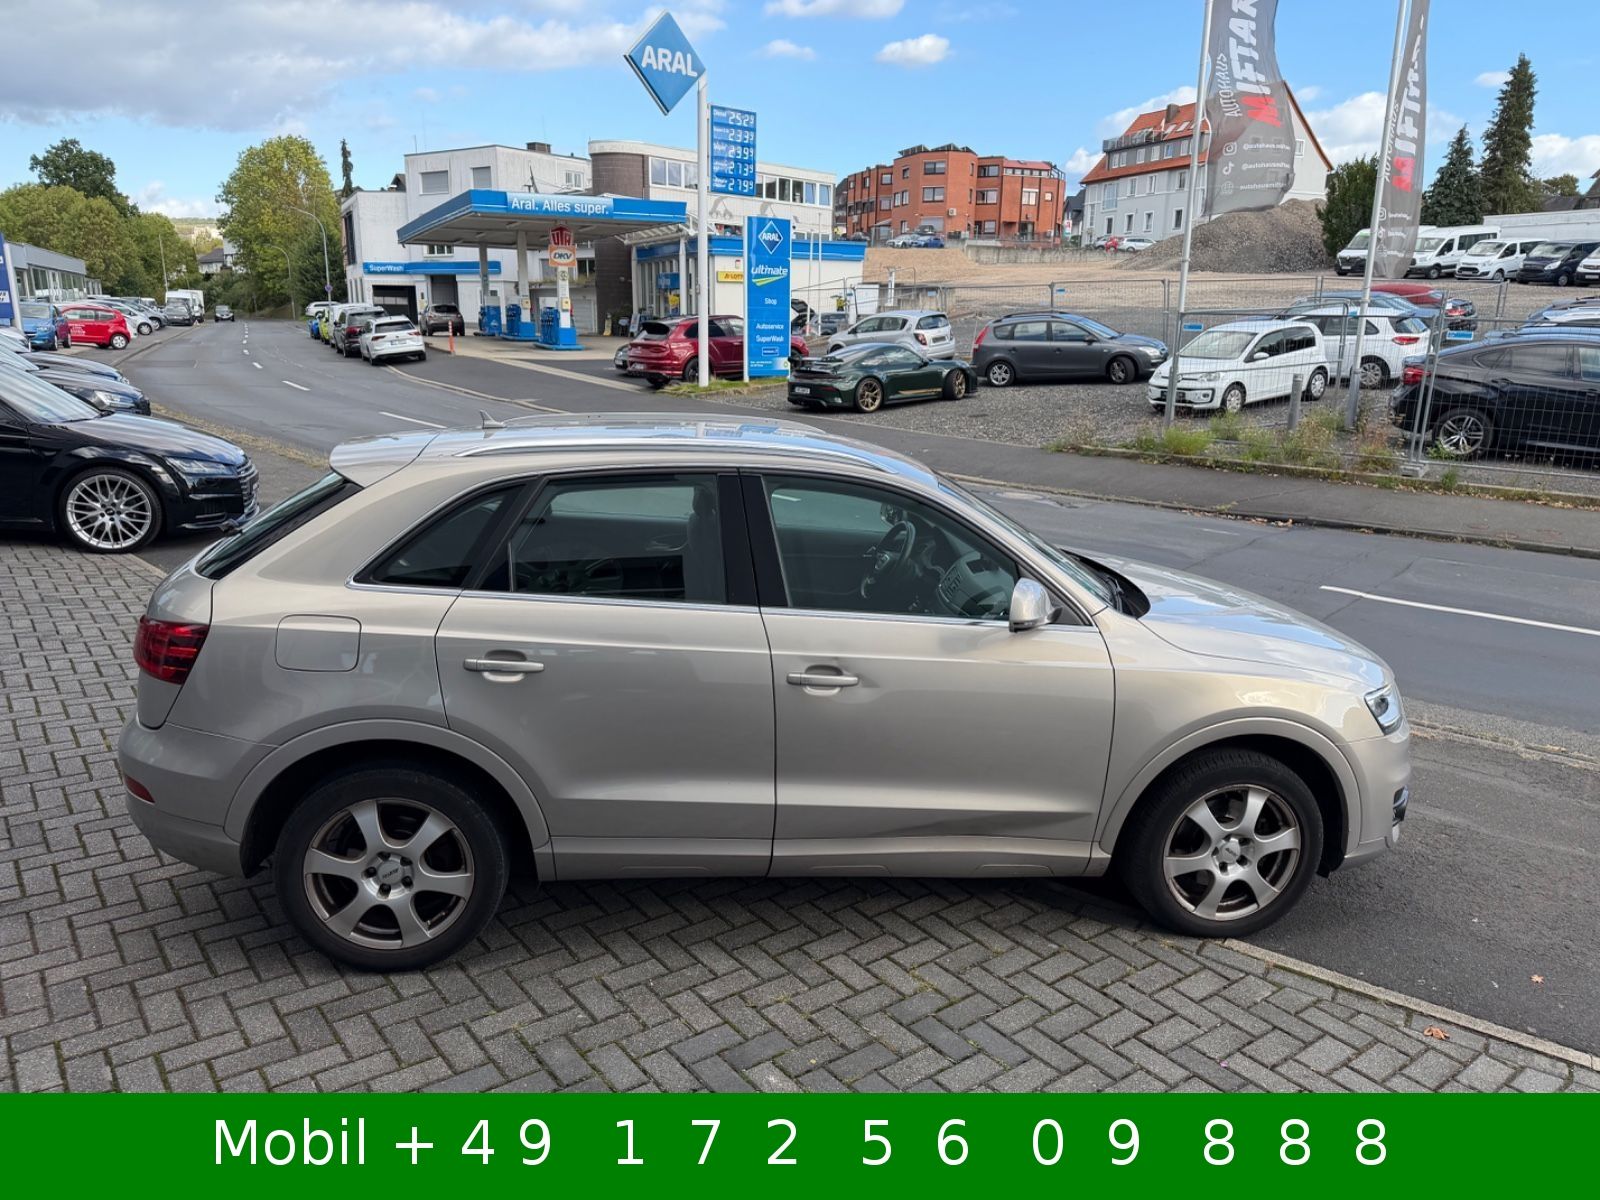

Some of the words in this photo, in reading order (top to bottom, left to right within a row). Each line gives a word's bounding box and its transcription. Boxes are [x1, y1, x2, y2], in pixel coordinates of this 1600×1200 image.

[641, 45, 698, 78] ARAL
[1216, 52, 1242, 117] AUTOHAUS
[511, 198, 538, 211] Aral.
[543, 200, 571, 213] Alles
[574, 203, 609, 216] super.
[761, 232, 780, 242] ARAL
[553, 251, 572, 260] DKV
[751, 264, 788, 275] ultimate
